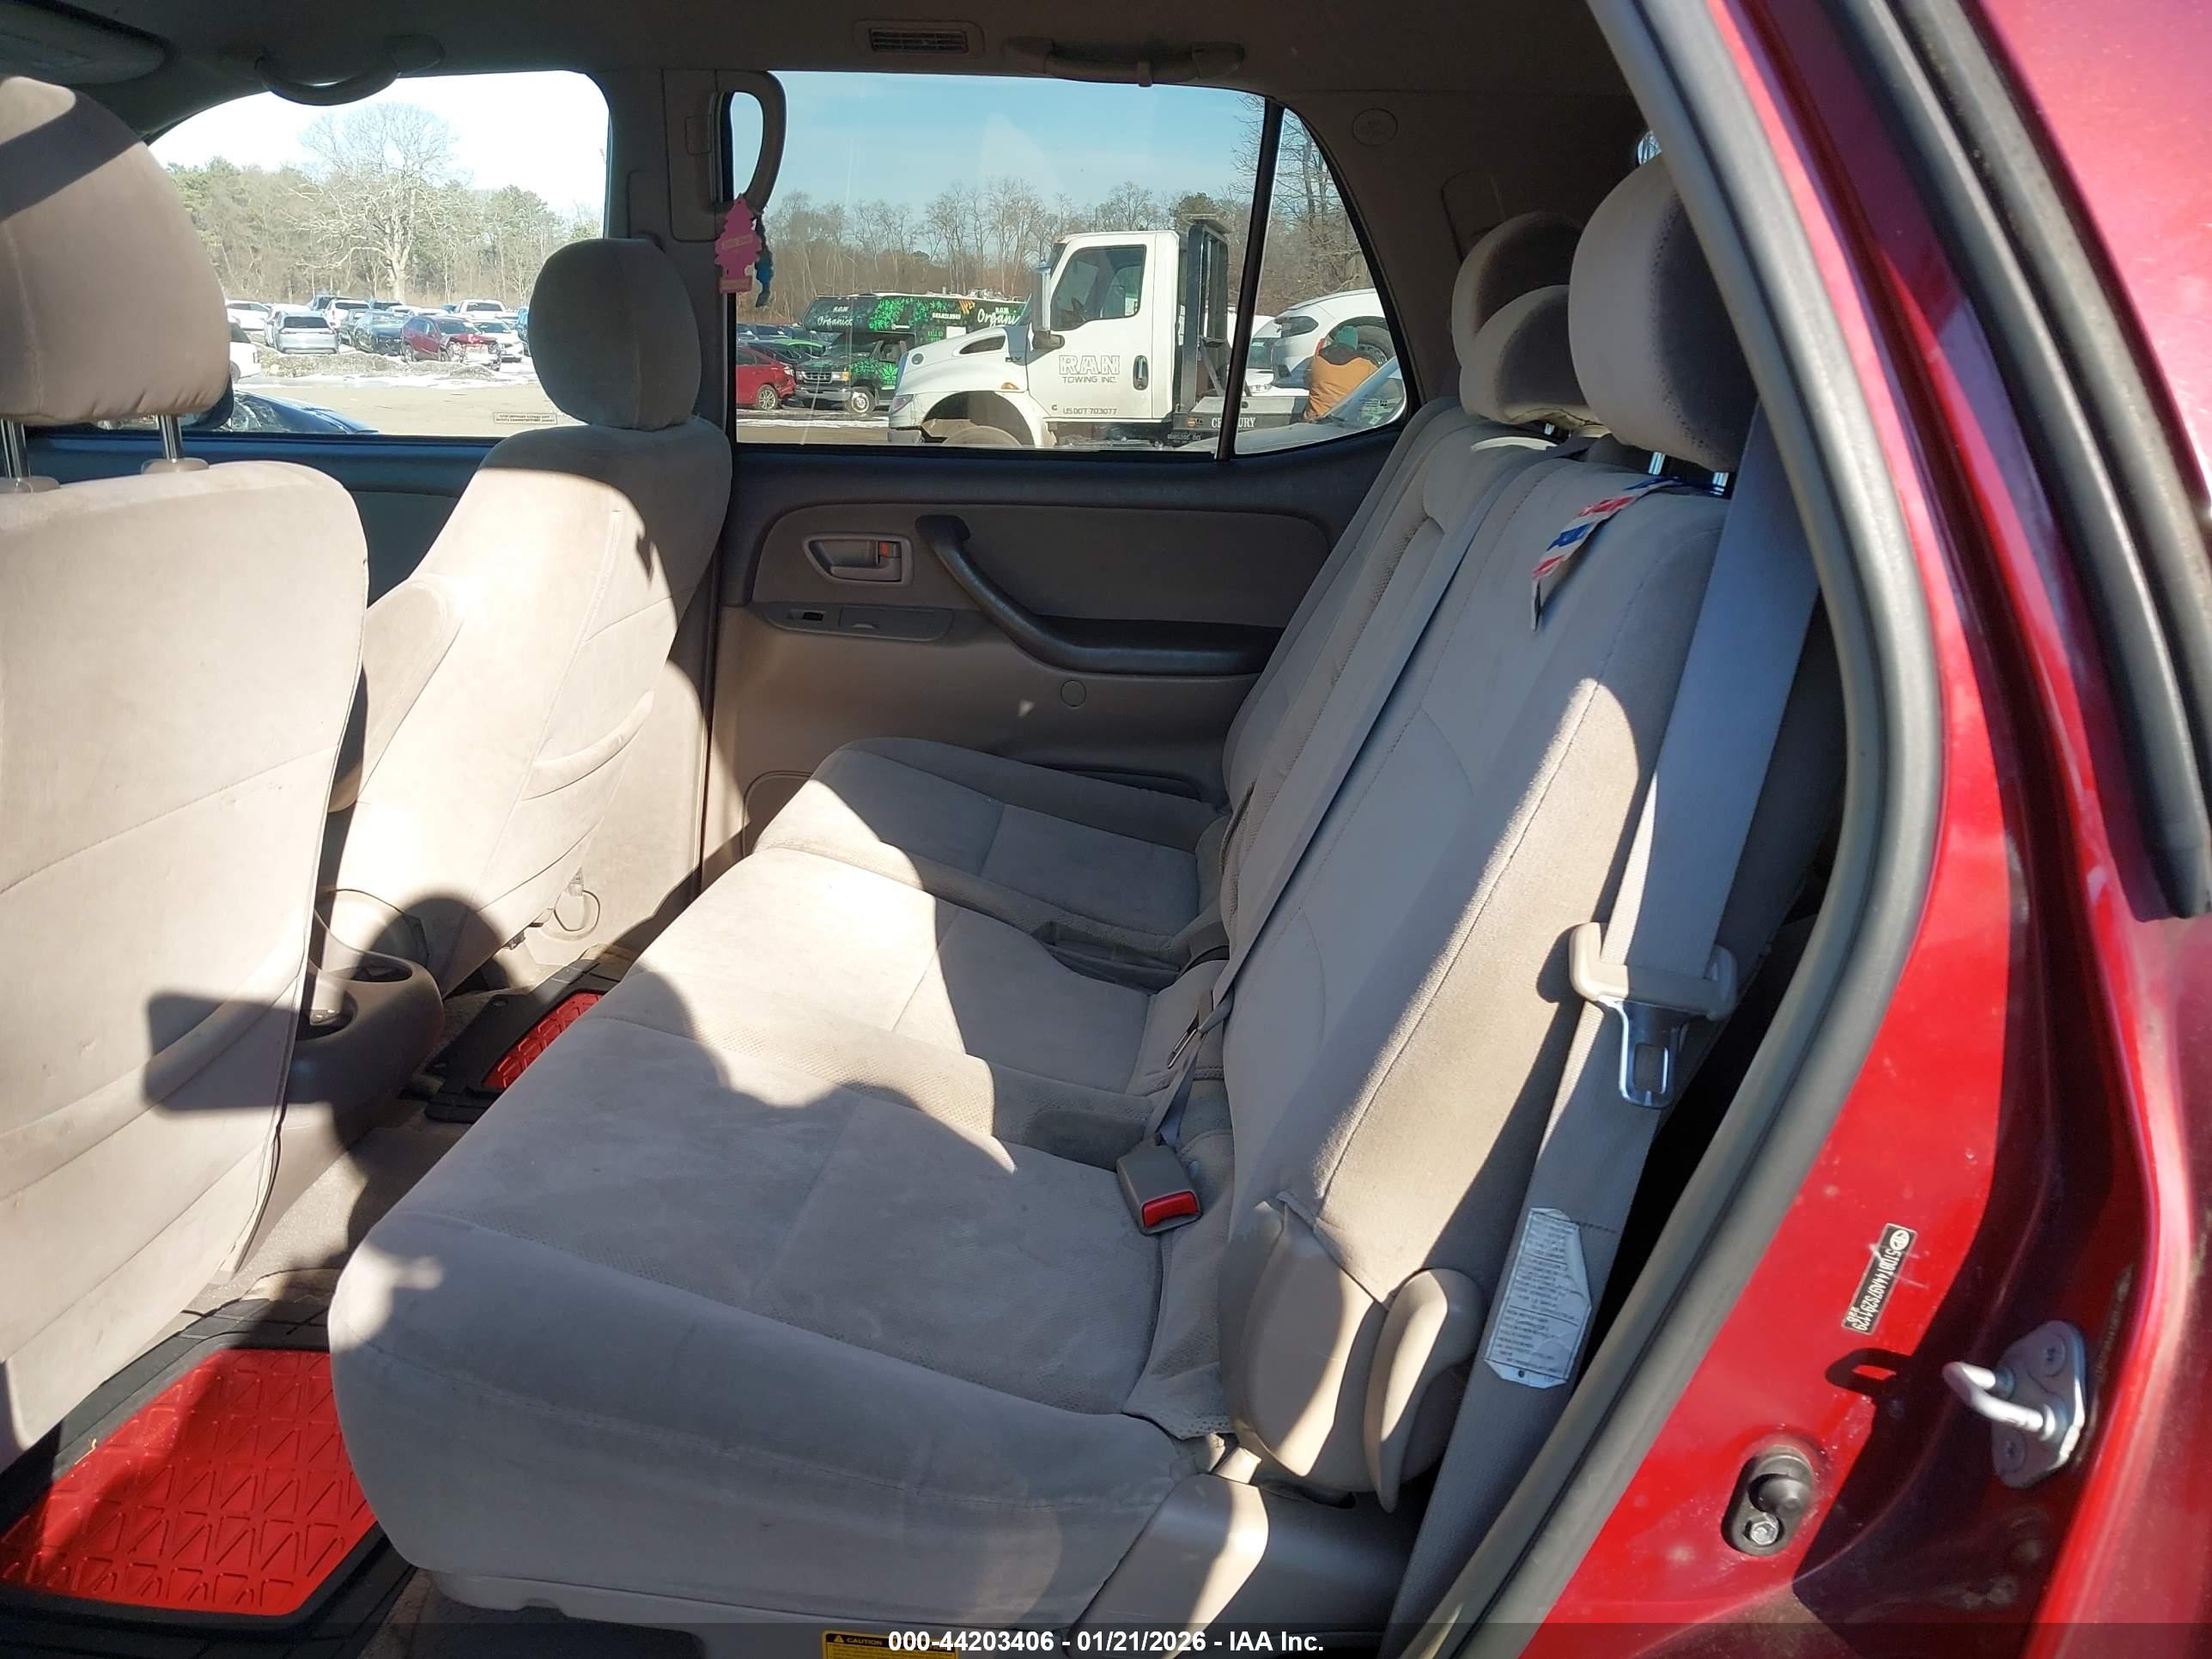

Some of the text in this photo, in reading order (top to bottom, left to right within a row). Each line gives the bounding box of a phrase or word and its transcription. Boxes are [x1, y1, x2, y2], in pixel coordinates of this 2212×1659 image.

[977, 307, 1021, 329] Organi
[1059, 355, 1121, 375] RAN
[1211, 416, 1256, 428] CEURY
[846, 1637, 883, 1646] CAUTION
